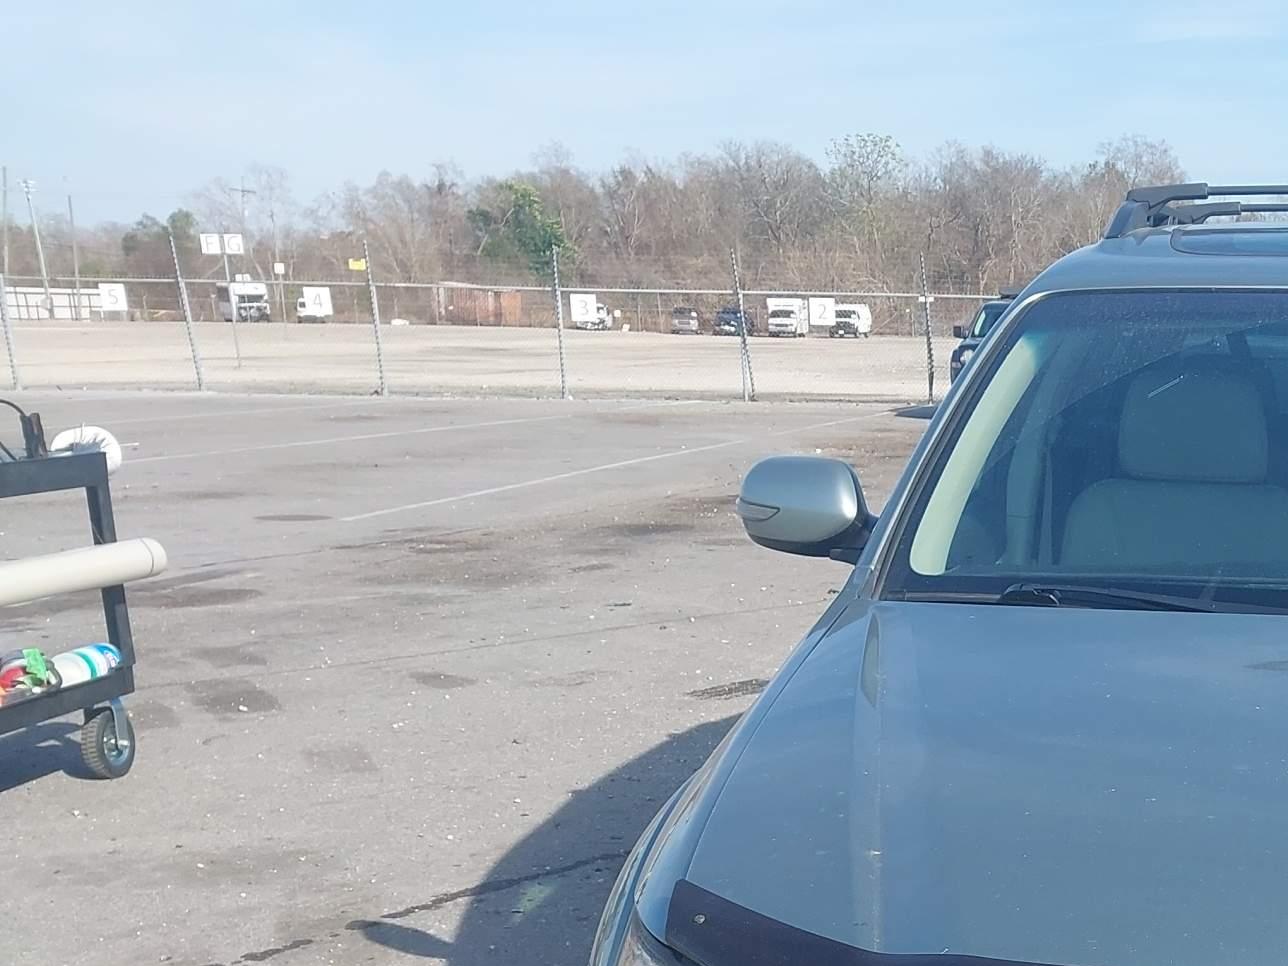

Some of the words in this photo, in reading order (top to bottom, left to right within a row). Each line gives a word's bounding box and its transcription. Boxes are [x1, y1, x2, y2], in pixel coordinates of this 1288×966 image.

[227, 235, 241, 252] G
[108, 289, 118, 304] 5
[313, 293, 323, 308] 4
[580, 299, 589, 316] 3
[818, 303, 827, 319] 2
